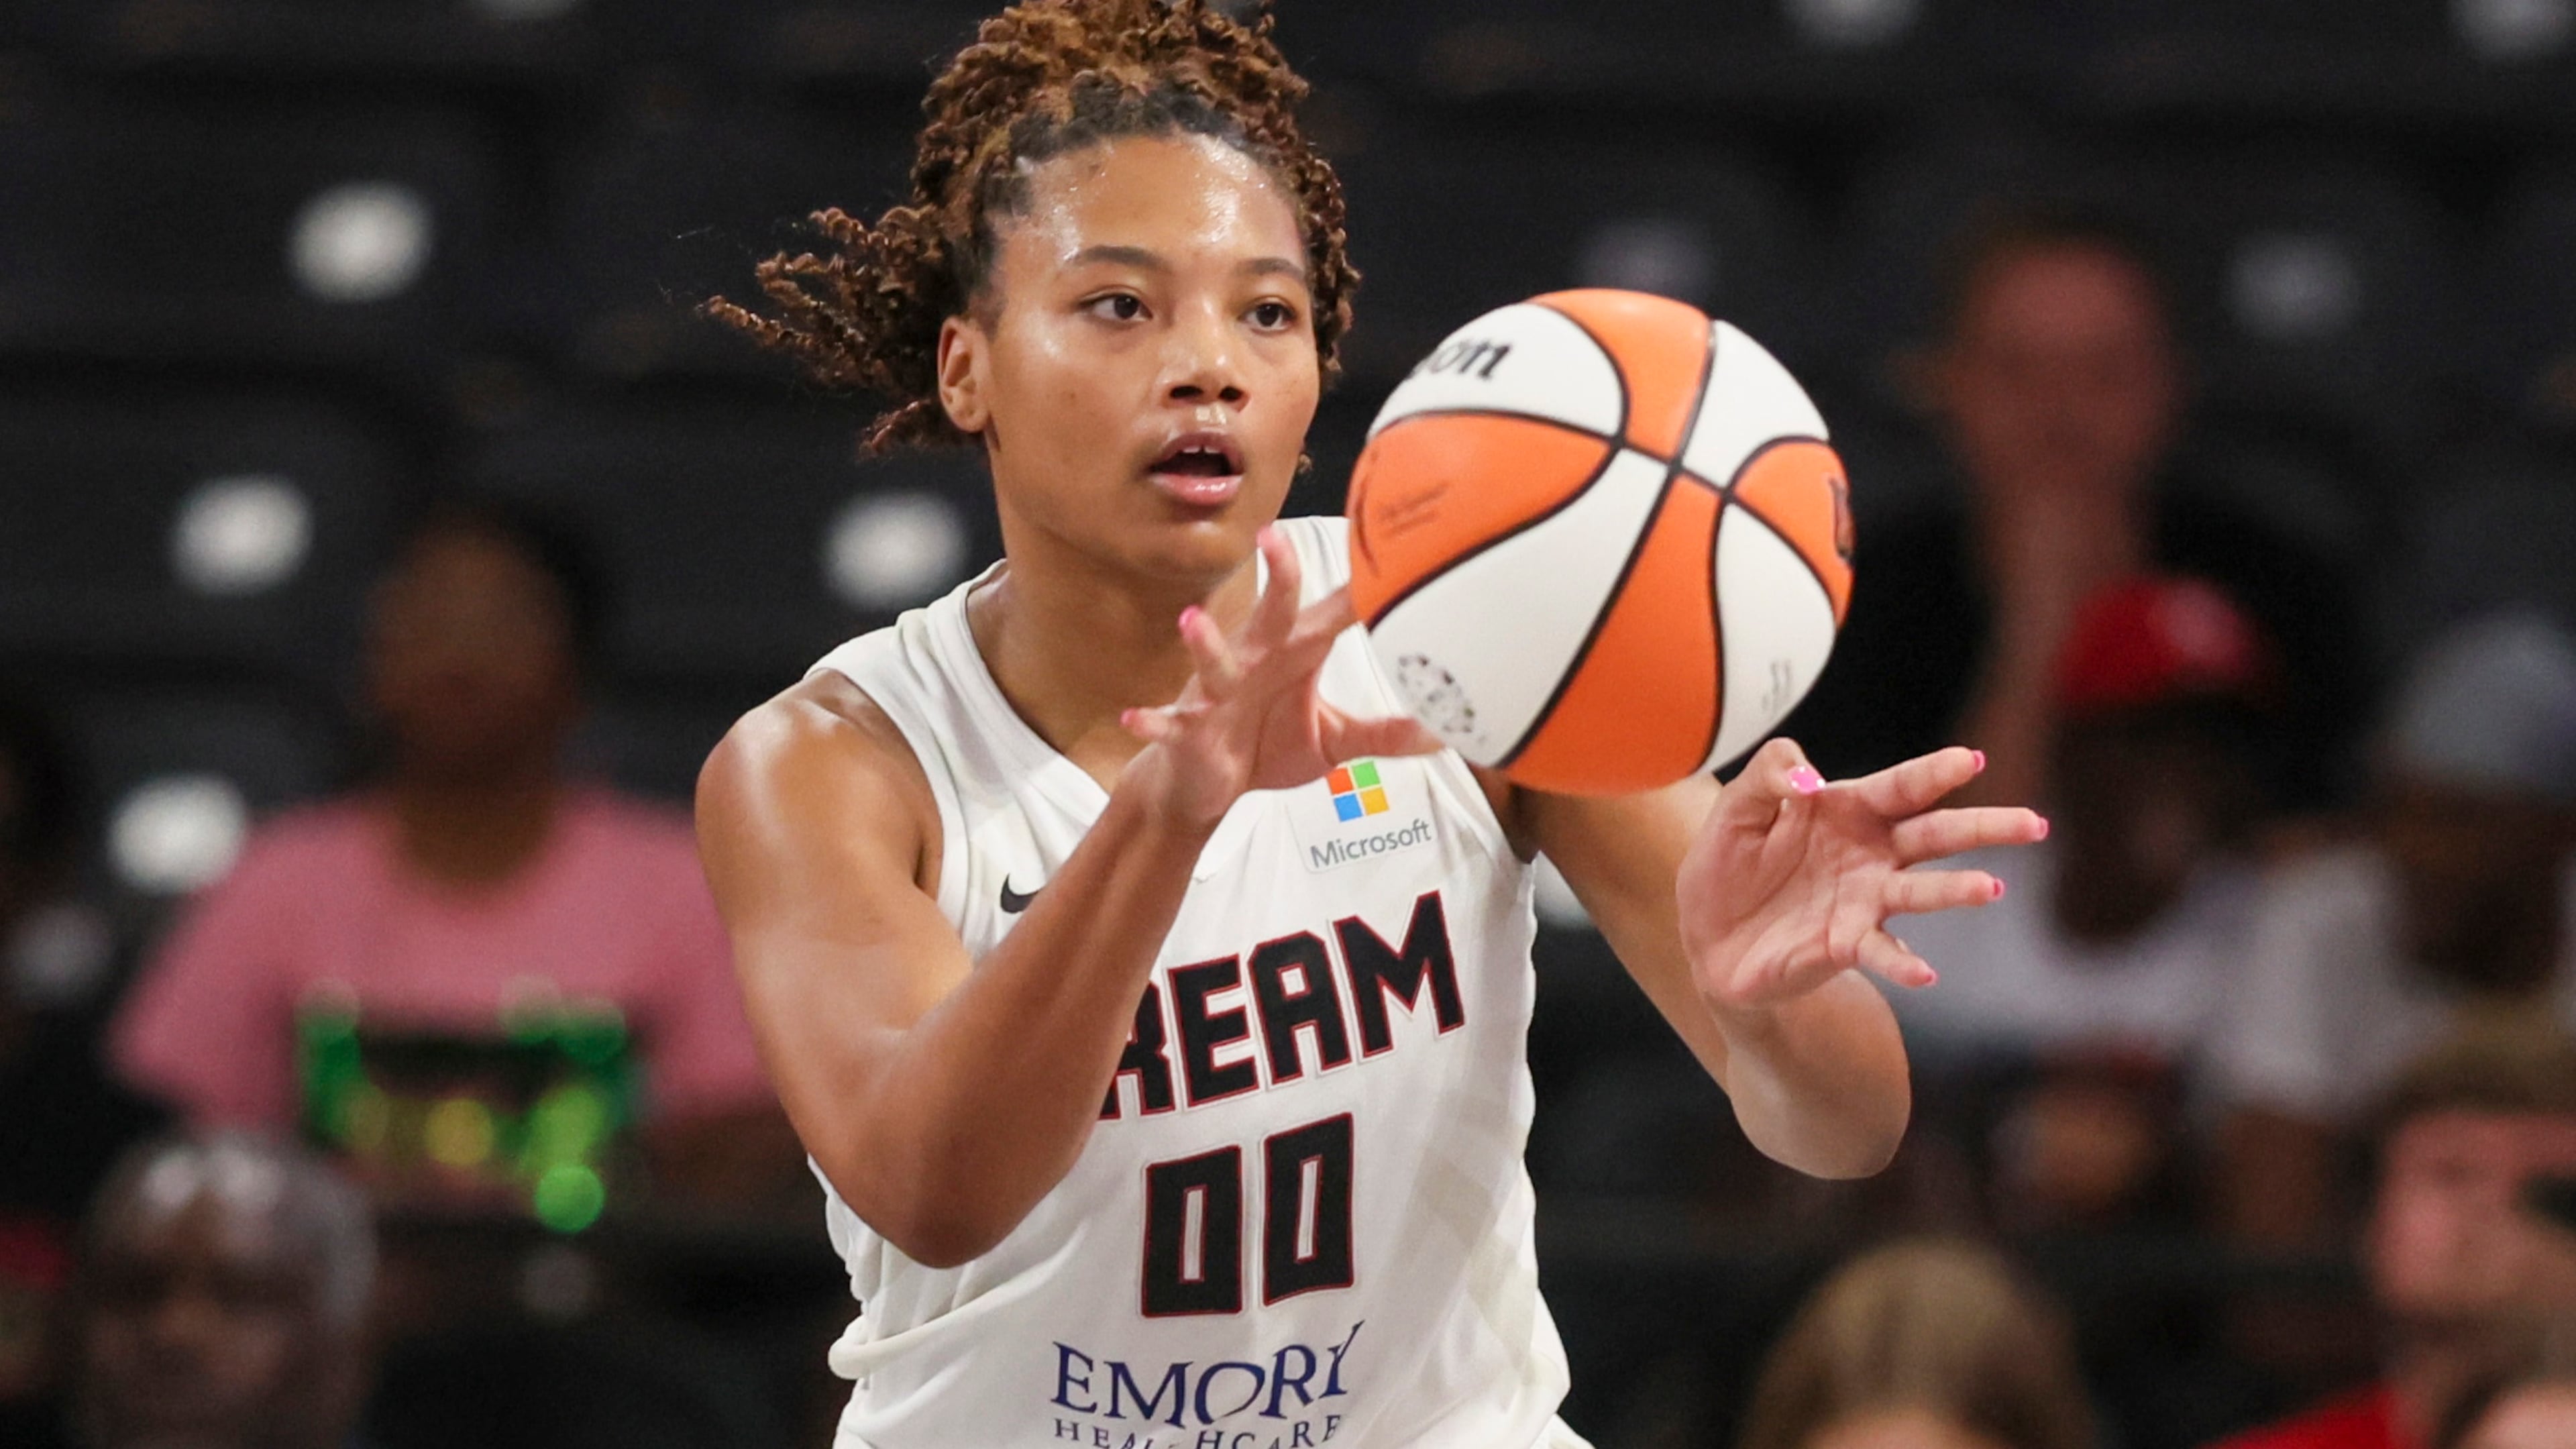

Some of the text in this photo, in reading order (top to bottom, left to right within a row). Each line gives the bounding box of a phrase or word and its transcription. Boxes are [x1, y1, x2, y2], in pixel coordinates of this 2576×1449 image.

[1407, 339, 1512, 379] on
[1310, 818, 1432, 868] Microsoft
[1099, 890, 1464, 1120] REAM
[1142, 1113, 1354, 1318] 00
[1051, 1320, 1365, 1429] EMORY
[1055, 1414, 1341, 1449] HEAHCRE
